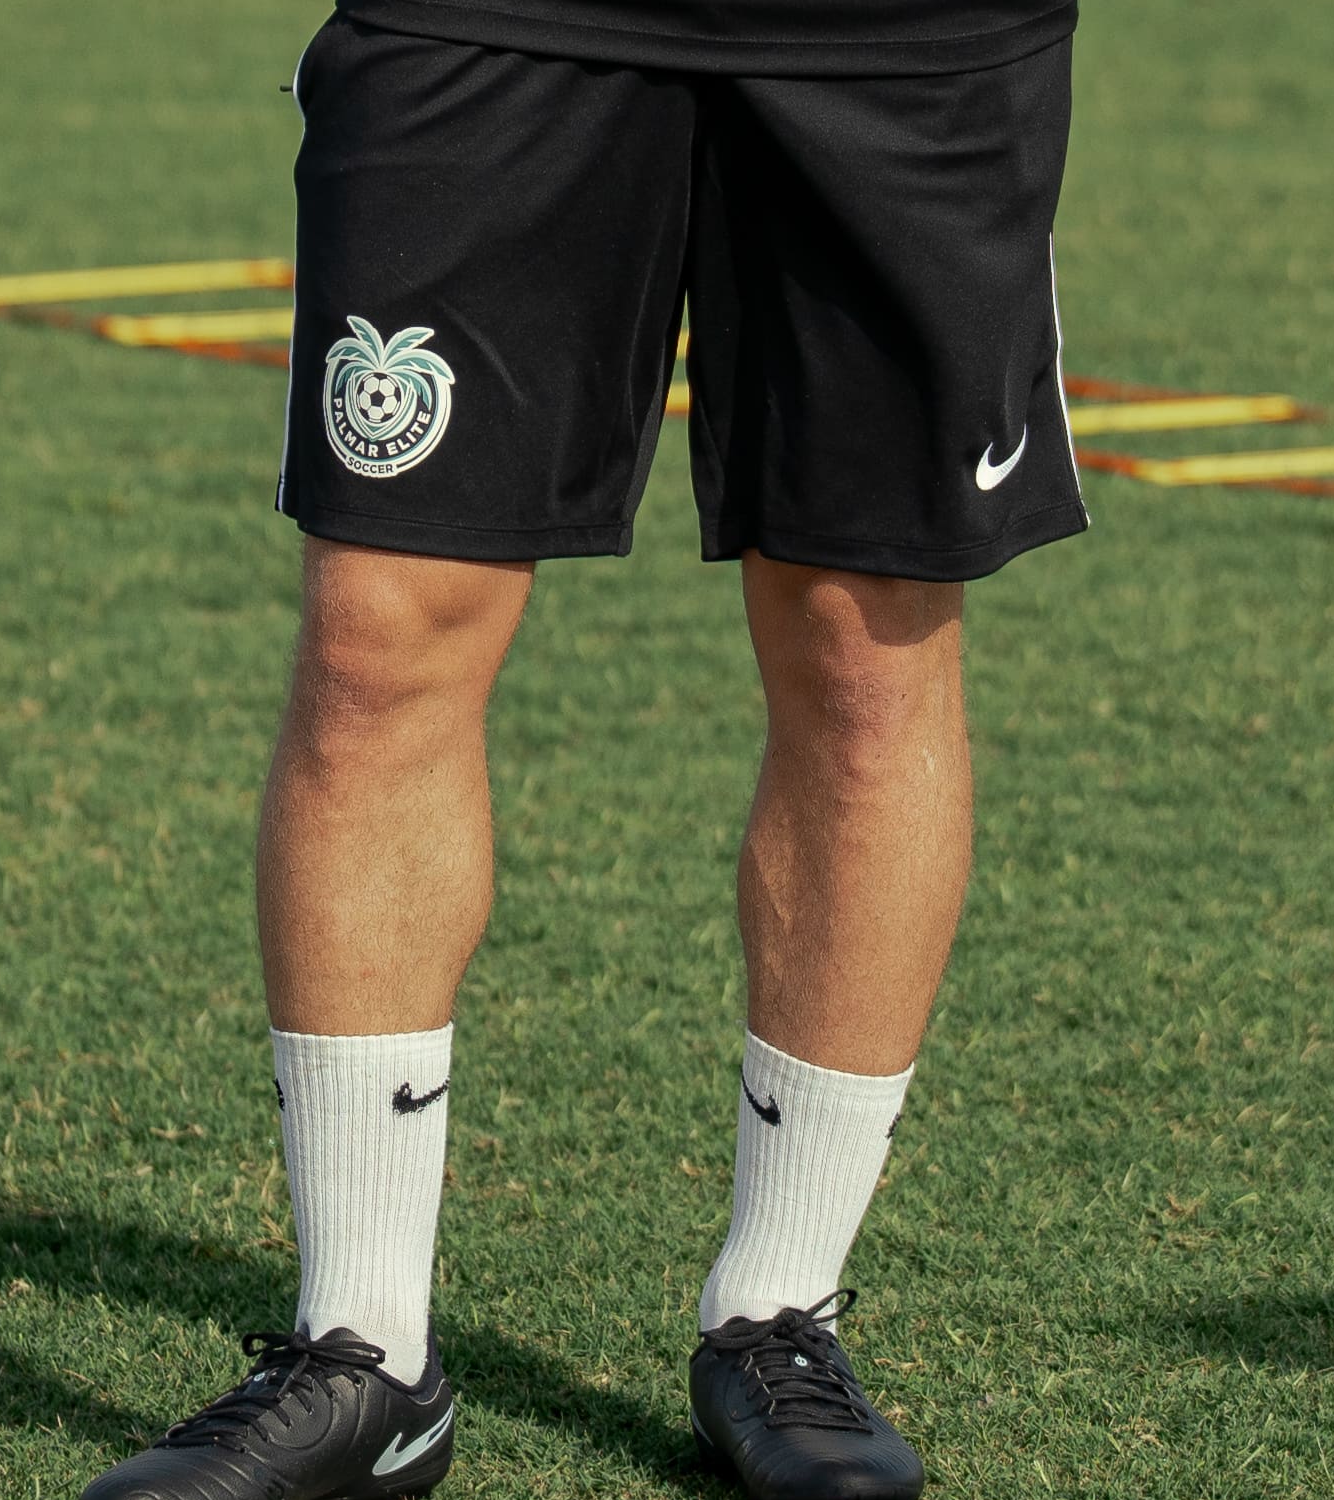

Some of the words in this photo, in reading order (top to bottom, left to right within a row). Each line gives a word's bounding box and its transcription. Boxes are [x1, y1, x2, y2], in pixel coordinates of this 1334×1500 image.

[333, 397, 379, 458] PALMAR
[385, 410, 431, 457] ELITE
[346, 456, 394, 474] SOCCER
